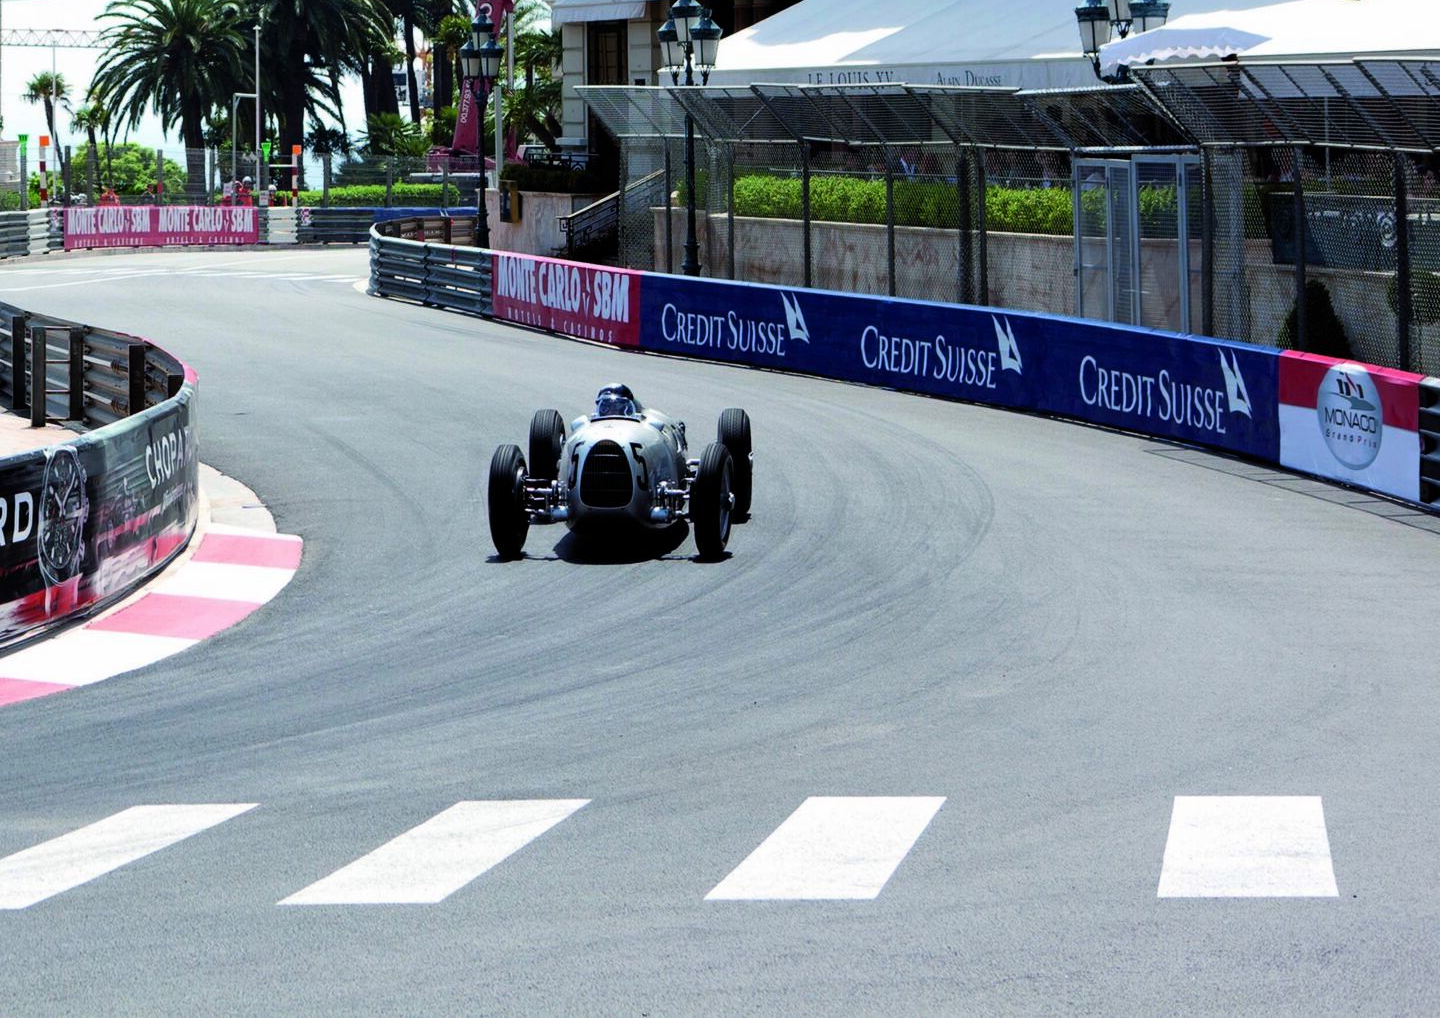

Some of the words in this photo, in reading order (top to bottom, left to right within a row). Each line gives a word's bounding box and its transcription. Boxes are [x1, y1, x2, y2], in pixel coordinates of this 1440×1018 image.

[68, 209, 97, 234] MONTE
[98, 208, 125, 233] CARLO
[131, 208, 151, 233] SBM
[158, 208, 190, 233] MONTE
[193, 208, 223, 233] CARLO
[231, 208, 254, 232] SBM
[497, 255, 537, 305] MONTE
[538, 262, 581, 314] CARLO
[593, 270, 630, 324] SBM
[508, 307, 542, 326] HOTELS
[563, 319, 613, 343] CASINOS
[661, 302, 725, 348] CREDIT
[728, 310, 786, 357] SUISSE
[861, 325, 932, 377] CREDIT
[933, 335, 997, 389] SUISSE
[1079, 355, 1155, 418] CREDIT
[1158, 369, 1227, 434] SUISSE
[1324, 406, 1377, 434] MONACO
[1325, 428, 1353, 442] Grand
[568, 441, 585, 490] 5
[629, 441, 649, 491] 5
